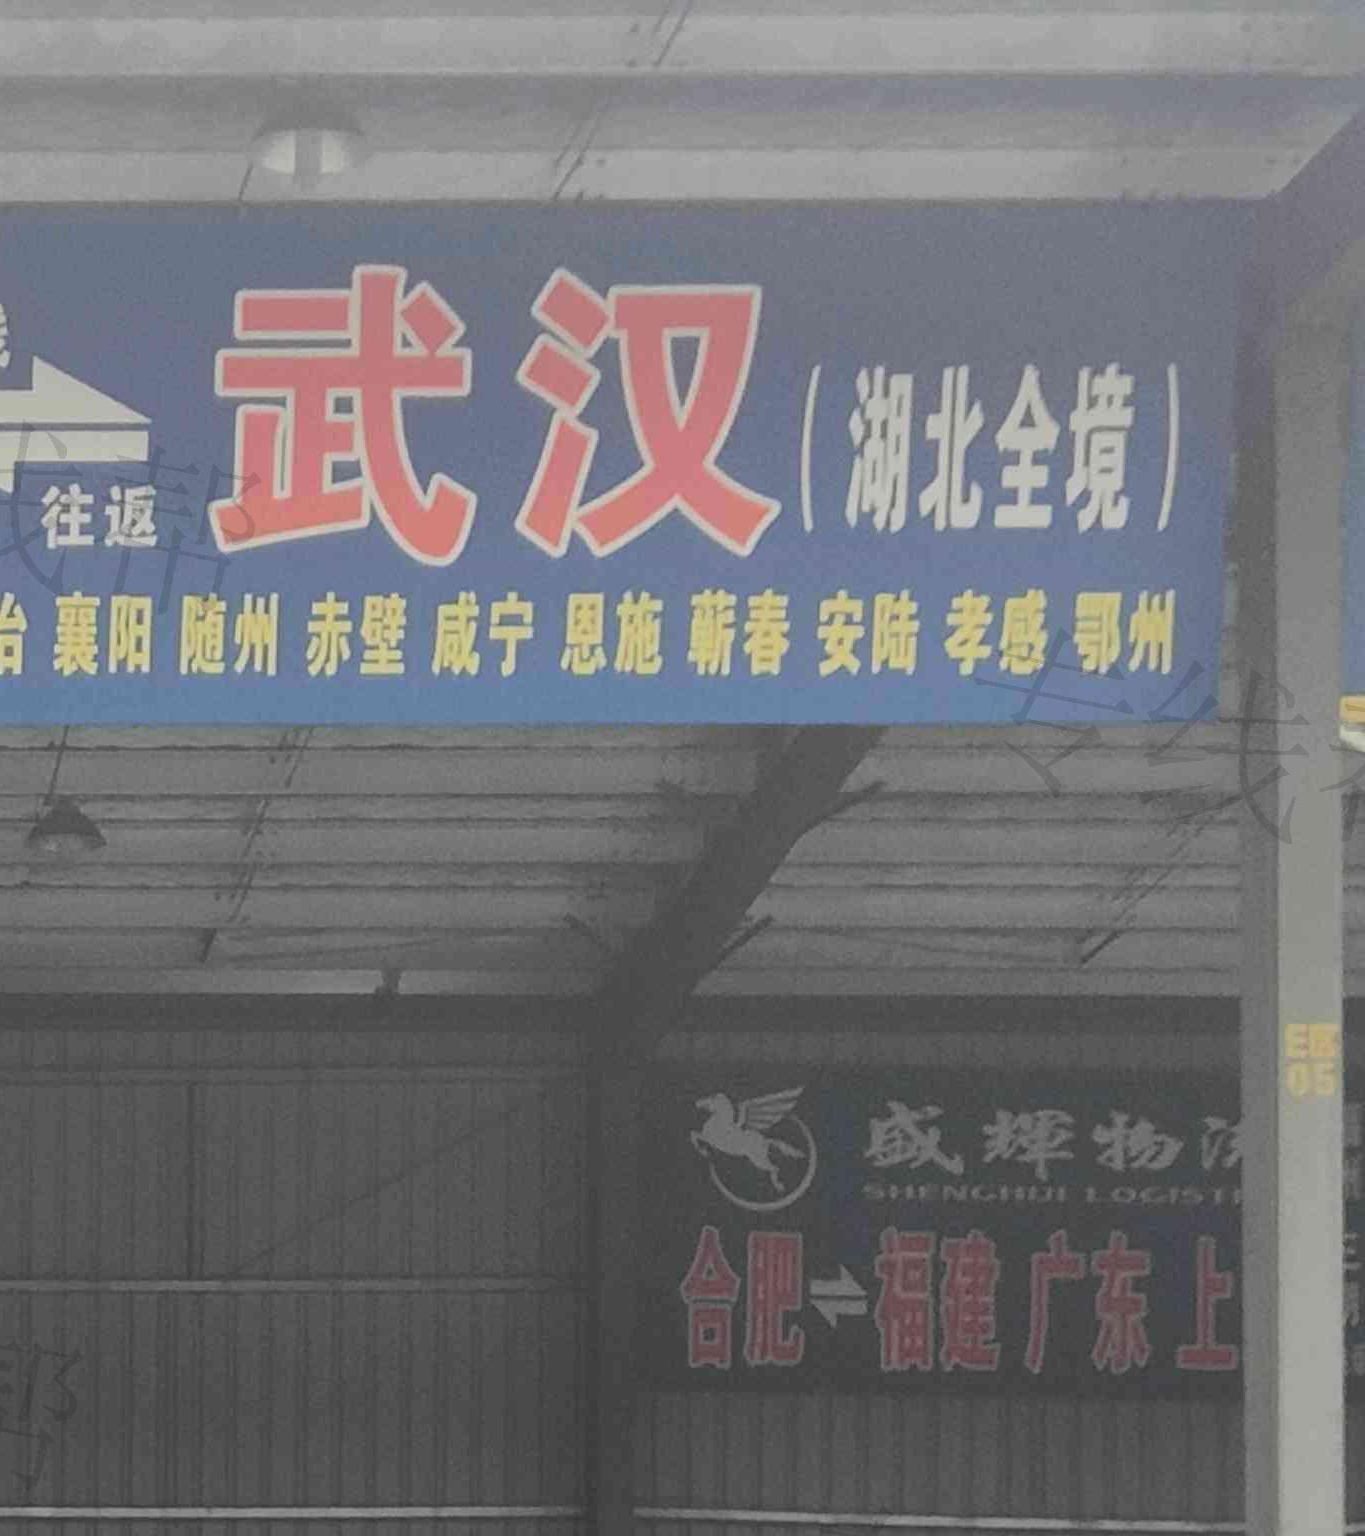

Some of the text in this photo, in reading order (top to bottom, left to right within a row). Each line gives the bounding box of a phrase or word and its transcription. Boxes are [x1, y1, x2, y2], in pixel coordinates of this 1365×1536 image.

[208, 264, 781, 566] 武汉
[40, 483, 159, 550] 往返
[53, 592, 152, 676] 襄阳
[179, 592, 279, 676] 随州
[306, 592, 406, 677] 赤壁
[432, 591, 534, 676] 咸宁
[561, 590, 663, 676] 恩施
[817, 590, 920, 676] 安陆
[944, 588, 1048, 676] 孝感
[1074, 589, 1175, 675] 鄂州
[680, 1225, 805, 1370] 合肥
[874, 1226, 1000, 1373] 福建
[1025, 1228, 1152, 1374] 广东
